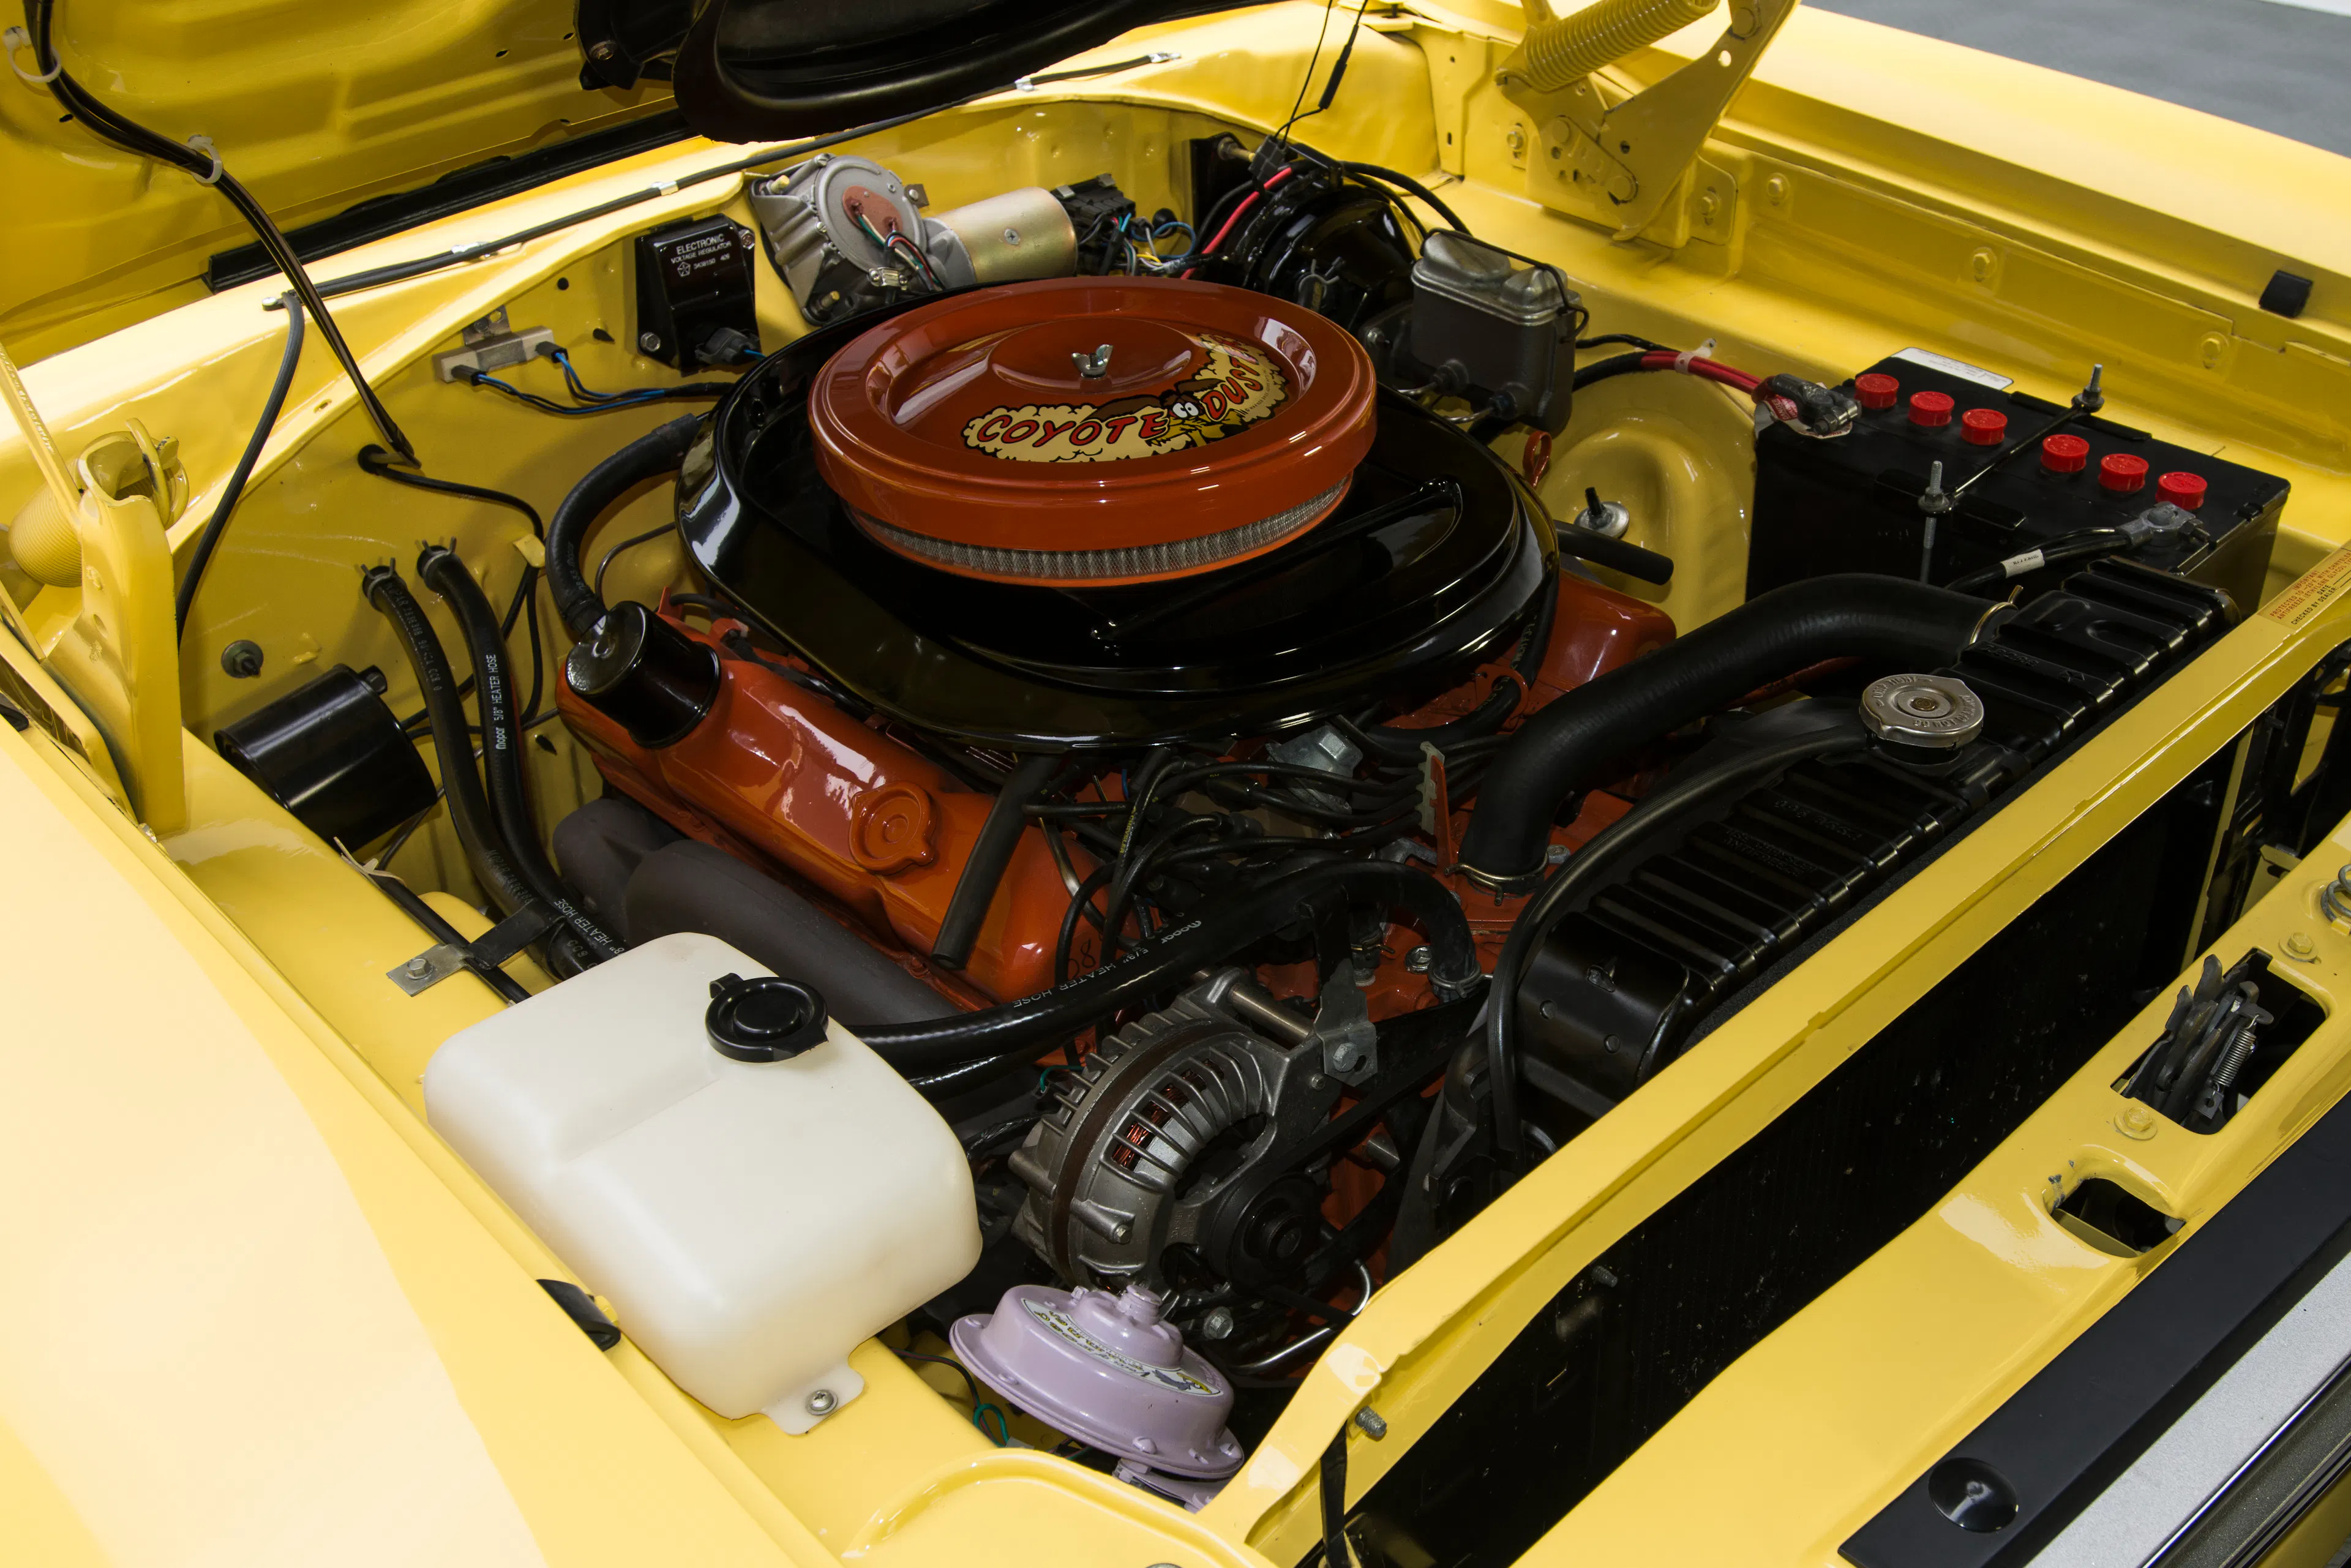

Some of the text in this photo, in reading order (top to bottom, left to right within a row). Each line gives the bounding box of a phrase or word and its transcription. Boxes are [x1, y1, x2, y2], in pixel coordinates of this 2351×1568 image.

[670, 241, 732, 264] VOLTAGE REGULATOR
[676, 233, 725, 255] ELECTRONIC
[977, 411, 1170, 448] COYOTE
[2292, 570, 2320, 590] IMPORTANT
[2317, 584, 2331, 595] DATE
[2270, 596, 2298, 617] PROTECTED
[2317, 569, 2330, 579] WITH
[2277, 597, 2306, 620] ANTIFREEZE
[2327, 565, 2347, 579] GLYCOL
[2291, 606, 2314, 625] CHECKED
[486, 653, 498, 673] HOSE
[490, 675, 503, 704] HEATER
[553, 898, 579, 918] HOSE
[574, 916, 613, 946] HEATER
[1059, 963, 1117, 991] HEATER
[1013, 989, 1052, 1008] HOSE
